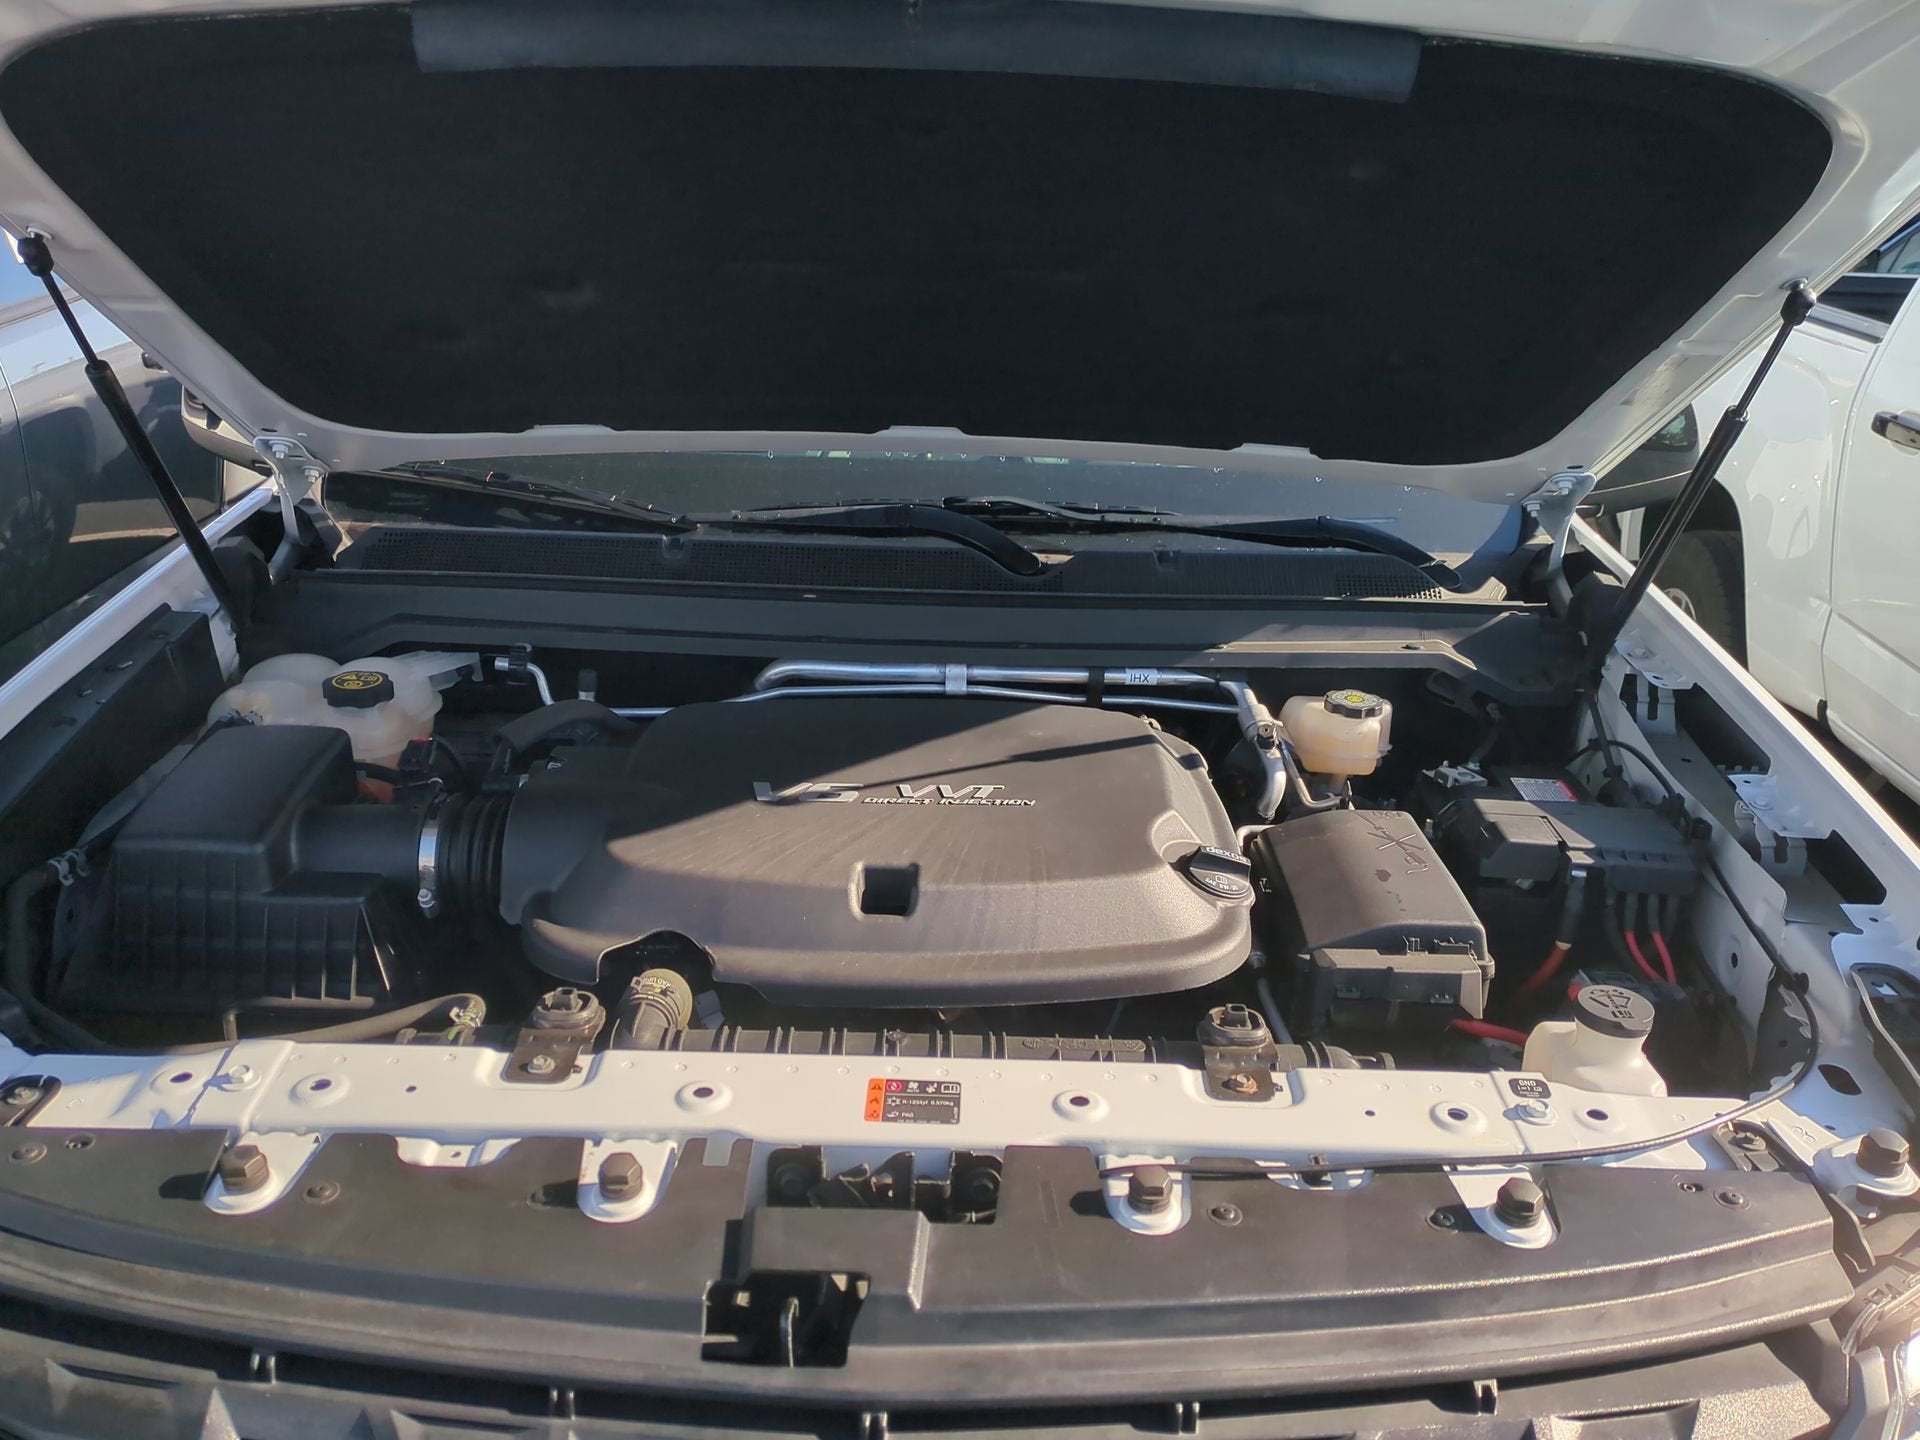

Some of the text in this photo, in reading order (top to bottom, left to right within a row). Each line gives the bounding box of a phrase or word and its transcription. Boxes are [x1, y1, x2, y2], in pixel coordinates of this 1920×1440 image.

[1130, 673, 1150, 683] IHX
[753, 782, 863, 802] V6
[896, 784, 1005, 799] VVT
[861, 797, 1036, 807] DIRECT INJECTION
[1206, 847, 1247, 863] dexos
